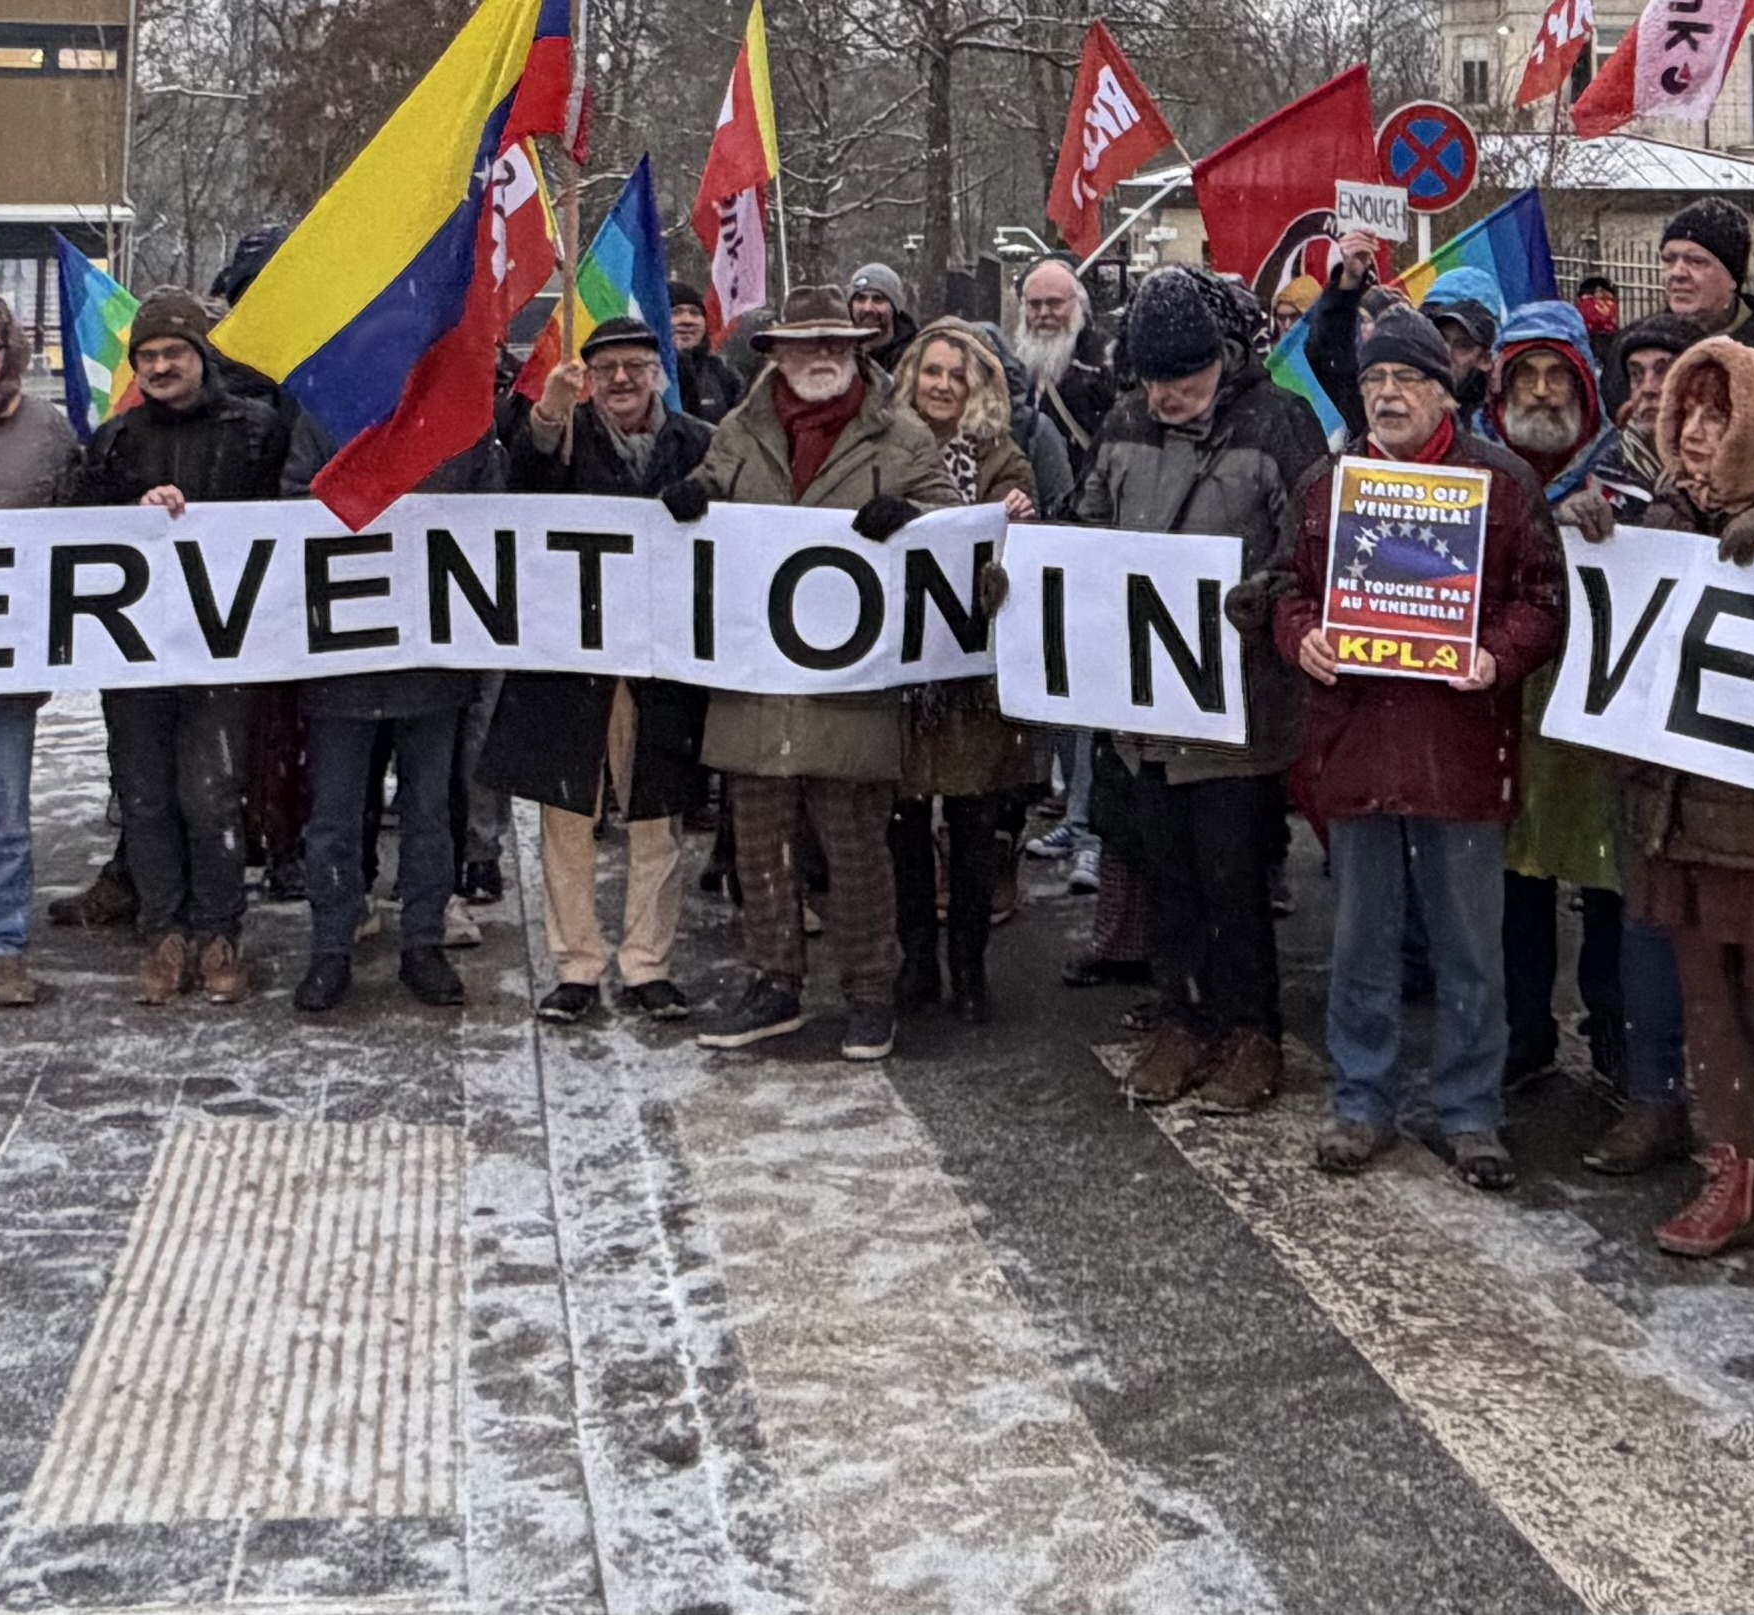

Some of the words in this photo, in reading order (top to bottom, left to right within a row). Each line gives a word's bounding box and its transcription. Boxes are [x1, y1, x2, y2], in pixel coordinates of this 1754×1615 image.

[1338, 191, 1407, 232] ENOUGH
[1359, 479, 1426, 500] HANDS
[1433, 487, 1469, 503] OFF
[1354, 499, 1471, 525] VENEZUELA!
[1337, 577, 1359, 592] NE
[1364, 580, 1435, 601] TOUCHEZ
[1439, 586, 1471, 604] PAS
[1340, 594, 1363, 610] AU
[1368, 597, 1465, 622] VENEZUELA!
[1041, 566, 1228, 715] IN
[1337, 634, 1425, 669] KPL
